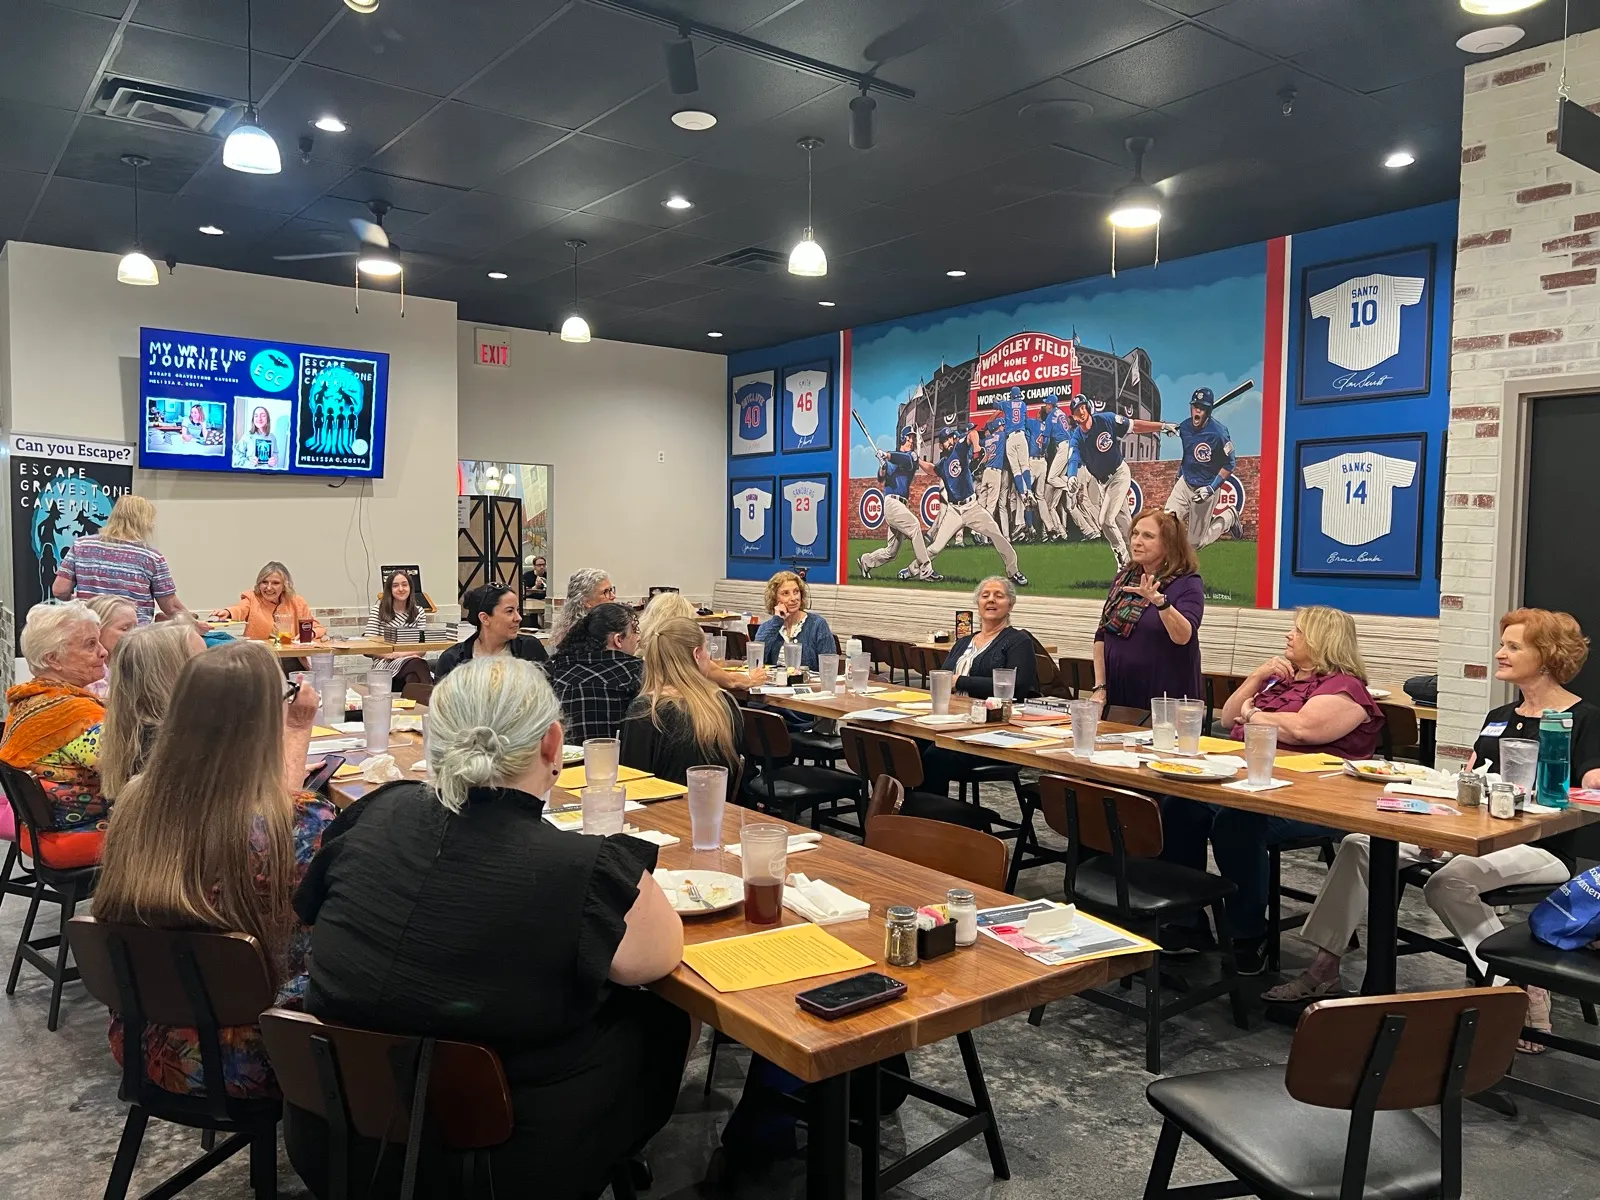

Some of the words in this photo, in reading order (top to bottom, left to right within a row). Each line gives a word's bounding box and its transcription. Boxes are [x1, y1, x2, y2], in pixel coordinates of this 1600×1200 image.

[1352, 285, 1378, 299] SANTO
[1350, 300, 1378, 328] 10
[149, 341, 172, 355] MY
[178, 344, 246, 361] WRITING
[481, 344, 508, 365] EXIT
[982, 338, 1031, 370] WRIGLEY
[1035, 338, 1068, 358] FIELD
[149, 354, 231, 373] JOURNEY
[304, 358, 346, 369] ESCAPE
[1004, 356, 1027, 368] HOME
[1032, 354, 1044, 363] OF
[175, 373, 211, 381] GRAVESTONE
[254, 362, 284, 387] EGC
[981, 370, 1030, 387] CHICAGO
[1035, 364, 1069, 378] CUBS
[1027, 384, 1071, 399] CHAMPIONS
[797, 392, 812, 412] 46
[745, 405, 760, 428] 40
[1012, 409, 1021, 423] 9
[16, 438, 43, 452] Can
[47, 444, 74, 456] you
[78, 444, 131, 461] Escape?
[301, 455, 334, 463] MELISSA
[19, 463, 86, 479] ESCAPE
[1342, 462, 1372, 474] BANKS
[20, 480, 131, 497] GRAVESTONE
[1346, 480, 1367, 505] 14
[20, 497, 99, 512] CAVERNS
[749, 503, 755, 520] 8
[796, 497, 810, 511] 23
